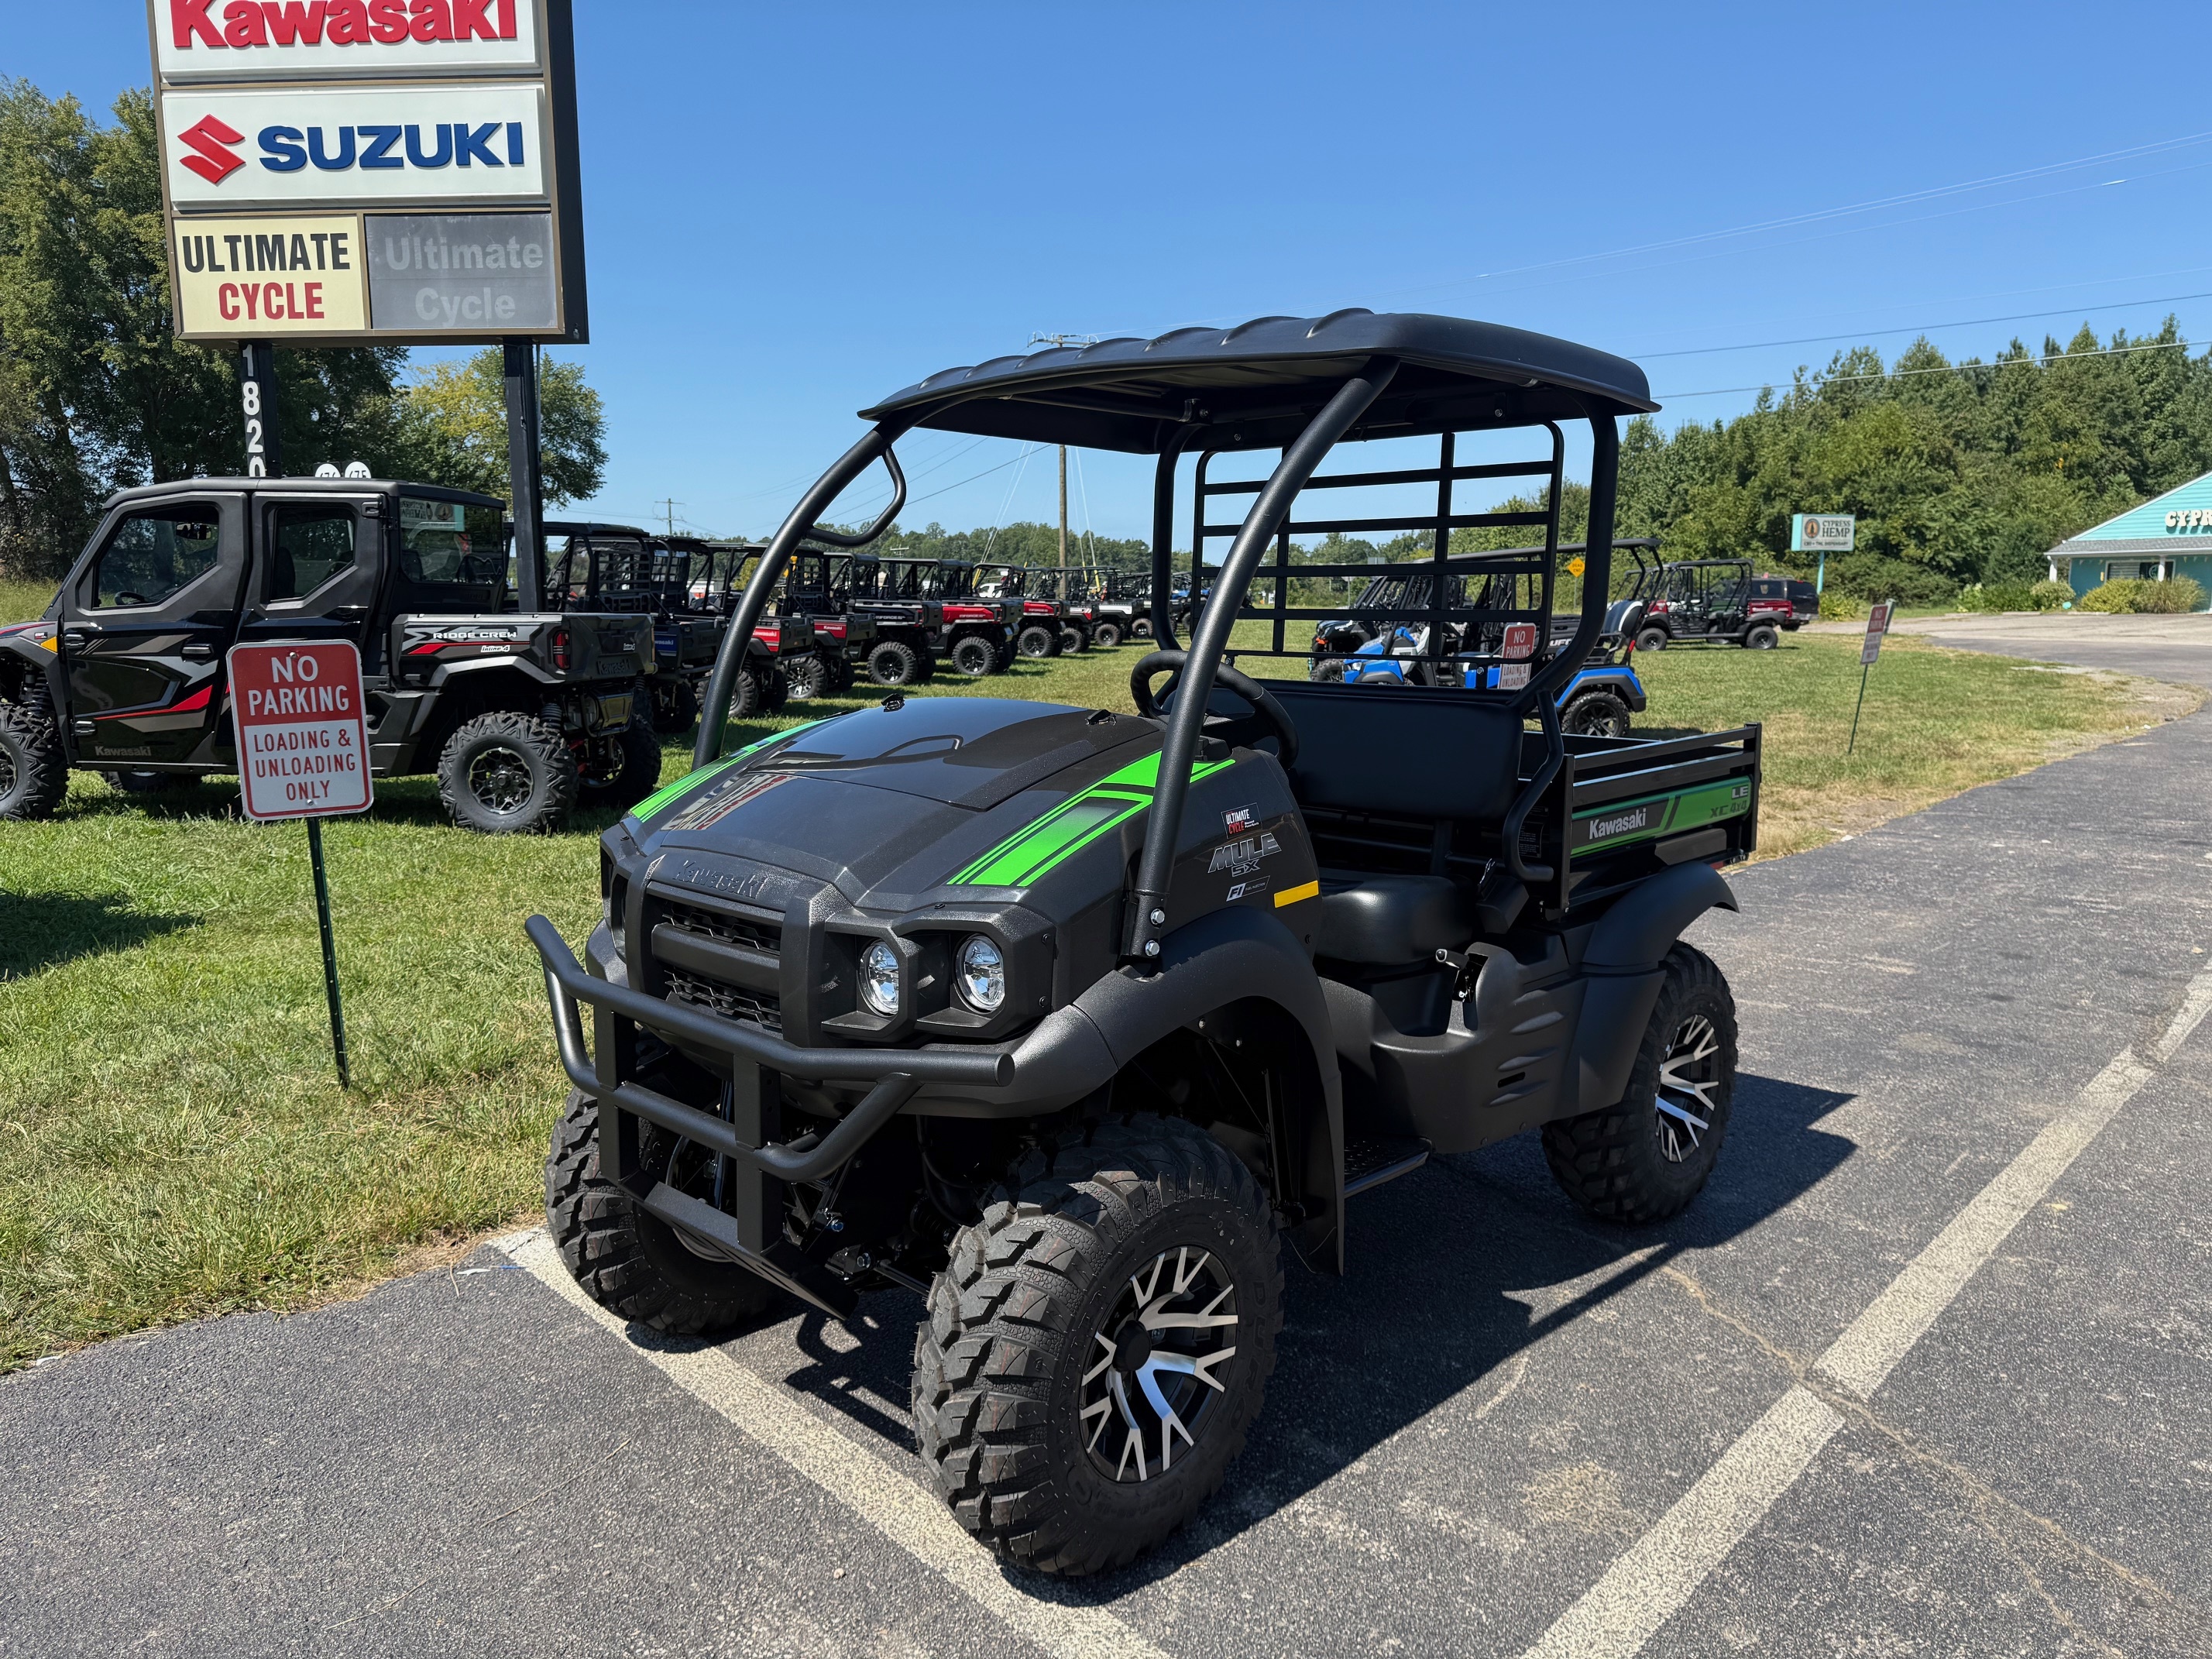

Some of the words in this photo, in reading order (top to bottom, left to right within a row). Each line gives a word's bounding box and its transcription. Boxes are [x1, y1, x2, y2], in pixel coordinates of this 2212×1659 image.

[170, 0, 517, 48] Kawasaki
[257, 122, 524, 171] SUZUKI
[182, 232, 350, 273] ULTIMATE
[386, 236, 544, 271] Ultimate
[218, 282, 325, 321] CYCLE
[415, 287, 516, 328] Cycle
[2165, 509, 2212, 527] CYPR
[1822, 527, 1850, 538] HEMP
[1513, 630, 1526, 644] NO
[1506, 644, 1530, 658] PARKING
[271, 655, 318, 683] NO
[248, 685, 349, 716] PARKING
[94, 746, 152, 757] Kawasaki
[254, 730, 329, 753] LOADING
[338, 728, 352, 747] &
[256, 753, 356, 778] UNLOADING
[286, 779, 331, 801] ONLY
[1731, 785, 1749, 799] LE
[1226, 809, 1250, 825] ULTIMATE
[1228, 821, 1245, 834] CYCLE
[1589, 808, 1647, 840] Kawasaki
[1207, 832, 1283, 874] MULE
[672, 860, 769, 899] Kawasaki
[1231, 859, 1261, 878] SX
